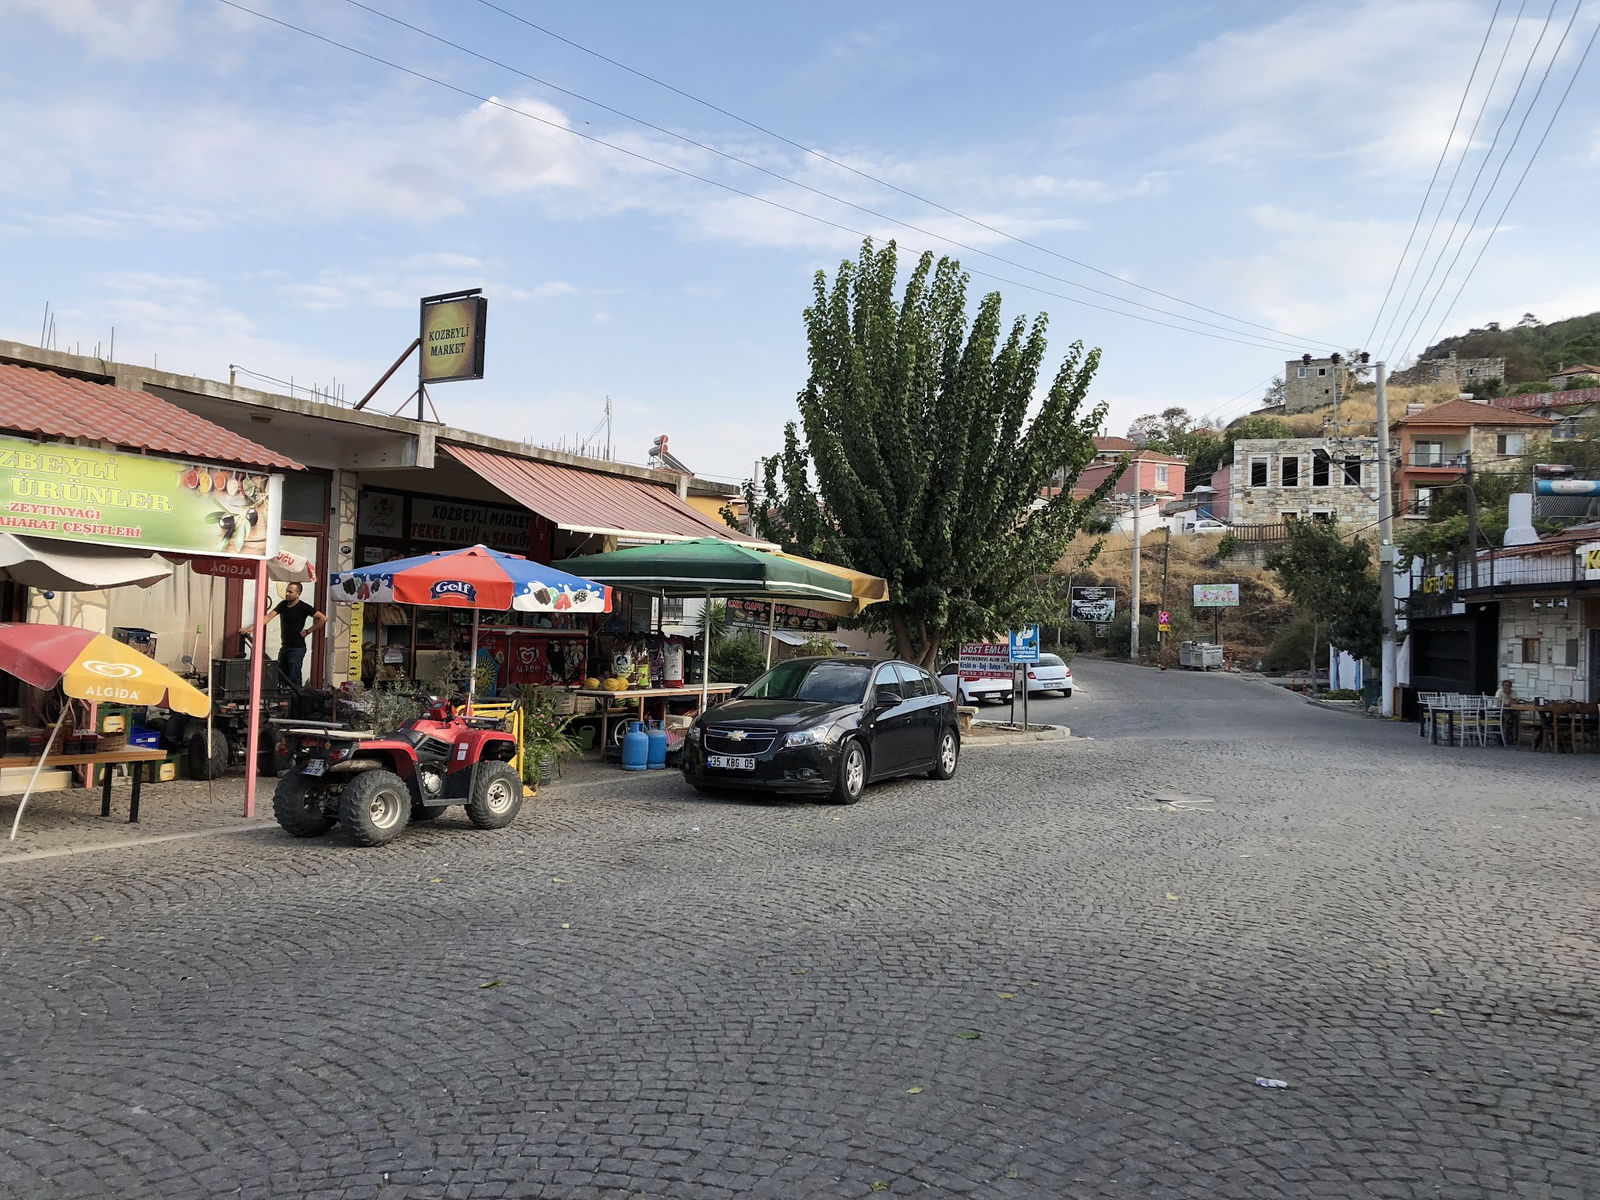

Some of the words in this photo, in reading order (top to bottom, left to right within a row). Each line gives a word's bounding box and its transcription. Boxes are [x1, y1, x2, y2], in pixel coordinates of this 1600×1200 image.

[428, 323, 470, 342] KOZBEYLİ
[430, 342, 466, 357] MARKET
[9, 471, 172, 513] ÜRÜNLER
[431, 504, 488, 524] KOZBEYLİ
[62, 521, 141, 539] ÇEŞİTLERİ
[411, 523, 446, 539] TEKEL
[435, 581, 471, 595] Golf
[962, 645, 983, 654] DOST
[85, 685, 139, 700] ALGIDA
[713, 756, 721, 767] 35
[745, 758, 754, 769] 05
